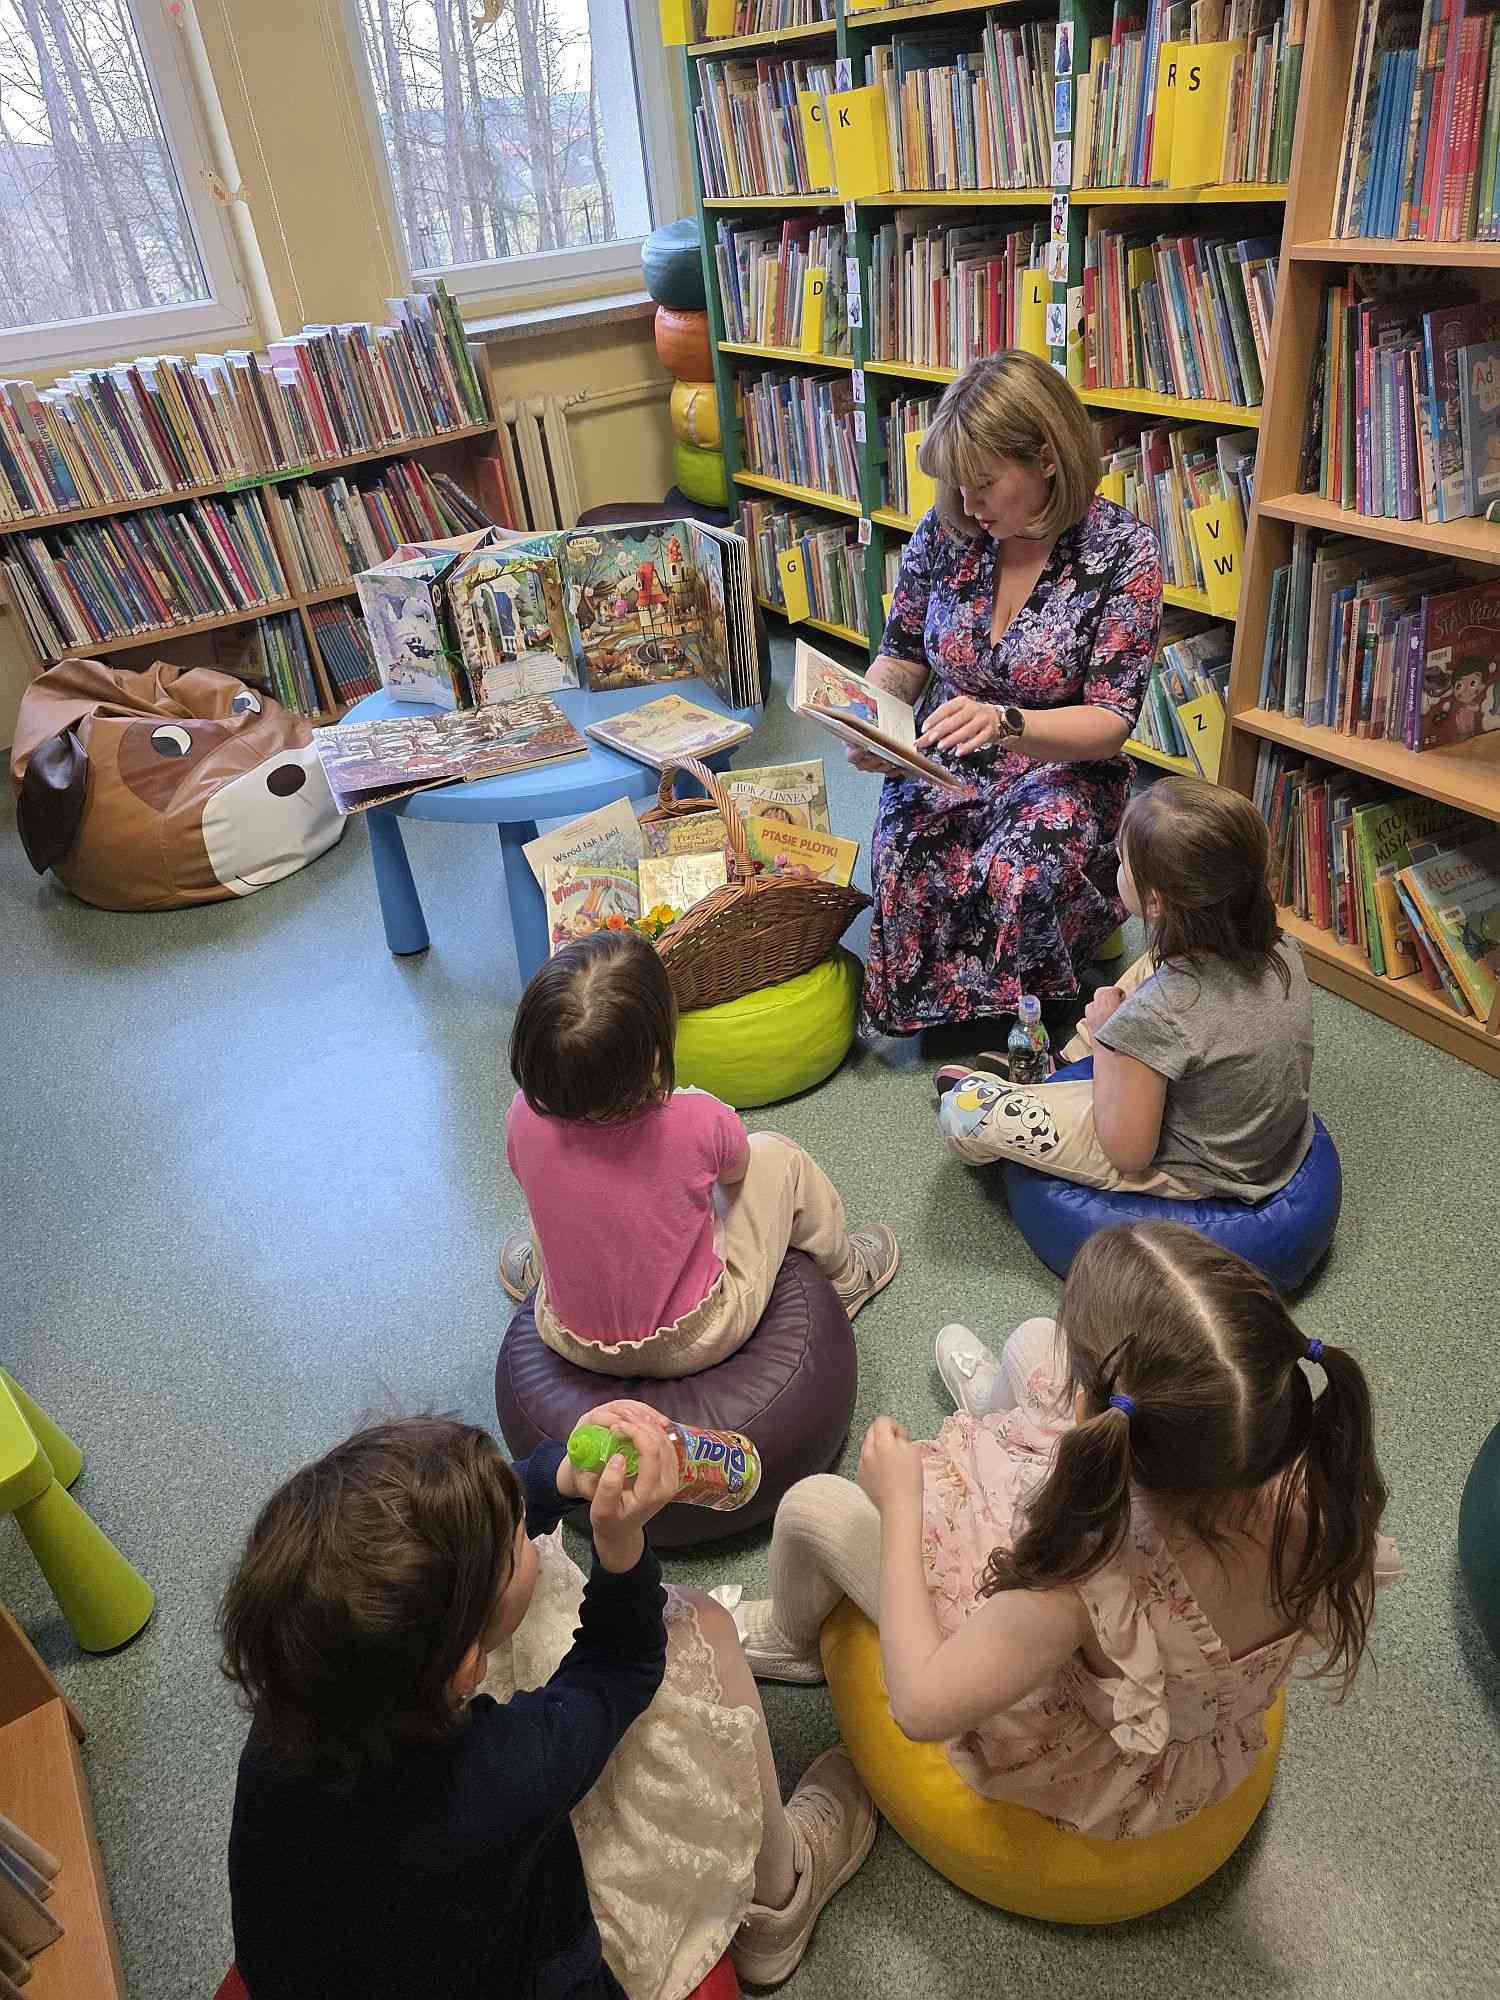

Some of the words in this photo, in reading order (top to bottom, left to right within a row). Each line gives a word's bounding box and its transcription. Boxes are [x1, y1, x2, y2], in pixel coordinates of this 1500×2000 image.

[1168, 63, 1176, 87] R
[1188, 66, 1201, 91] S
[810, 105, 821, 122] C
[838, 107, 851, 127] K
[813, 280, 824, 296] D
[1033, 285, 1042, 304] L
[1206, 519, 1221, 539] V
[787, 560, 797, 573] G
[1213, 554, 1234, 576] W
[1192, 713, 1208, 732] Z
[736, 783, 757, 798] ROK
[761, 829, 798, 847] PTASIE
[799, 839, 839, 858] PLOTKI
